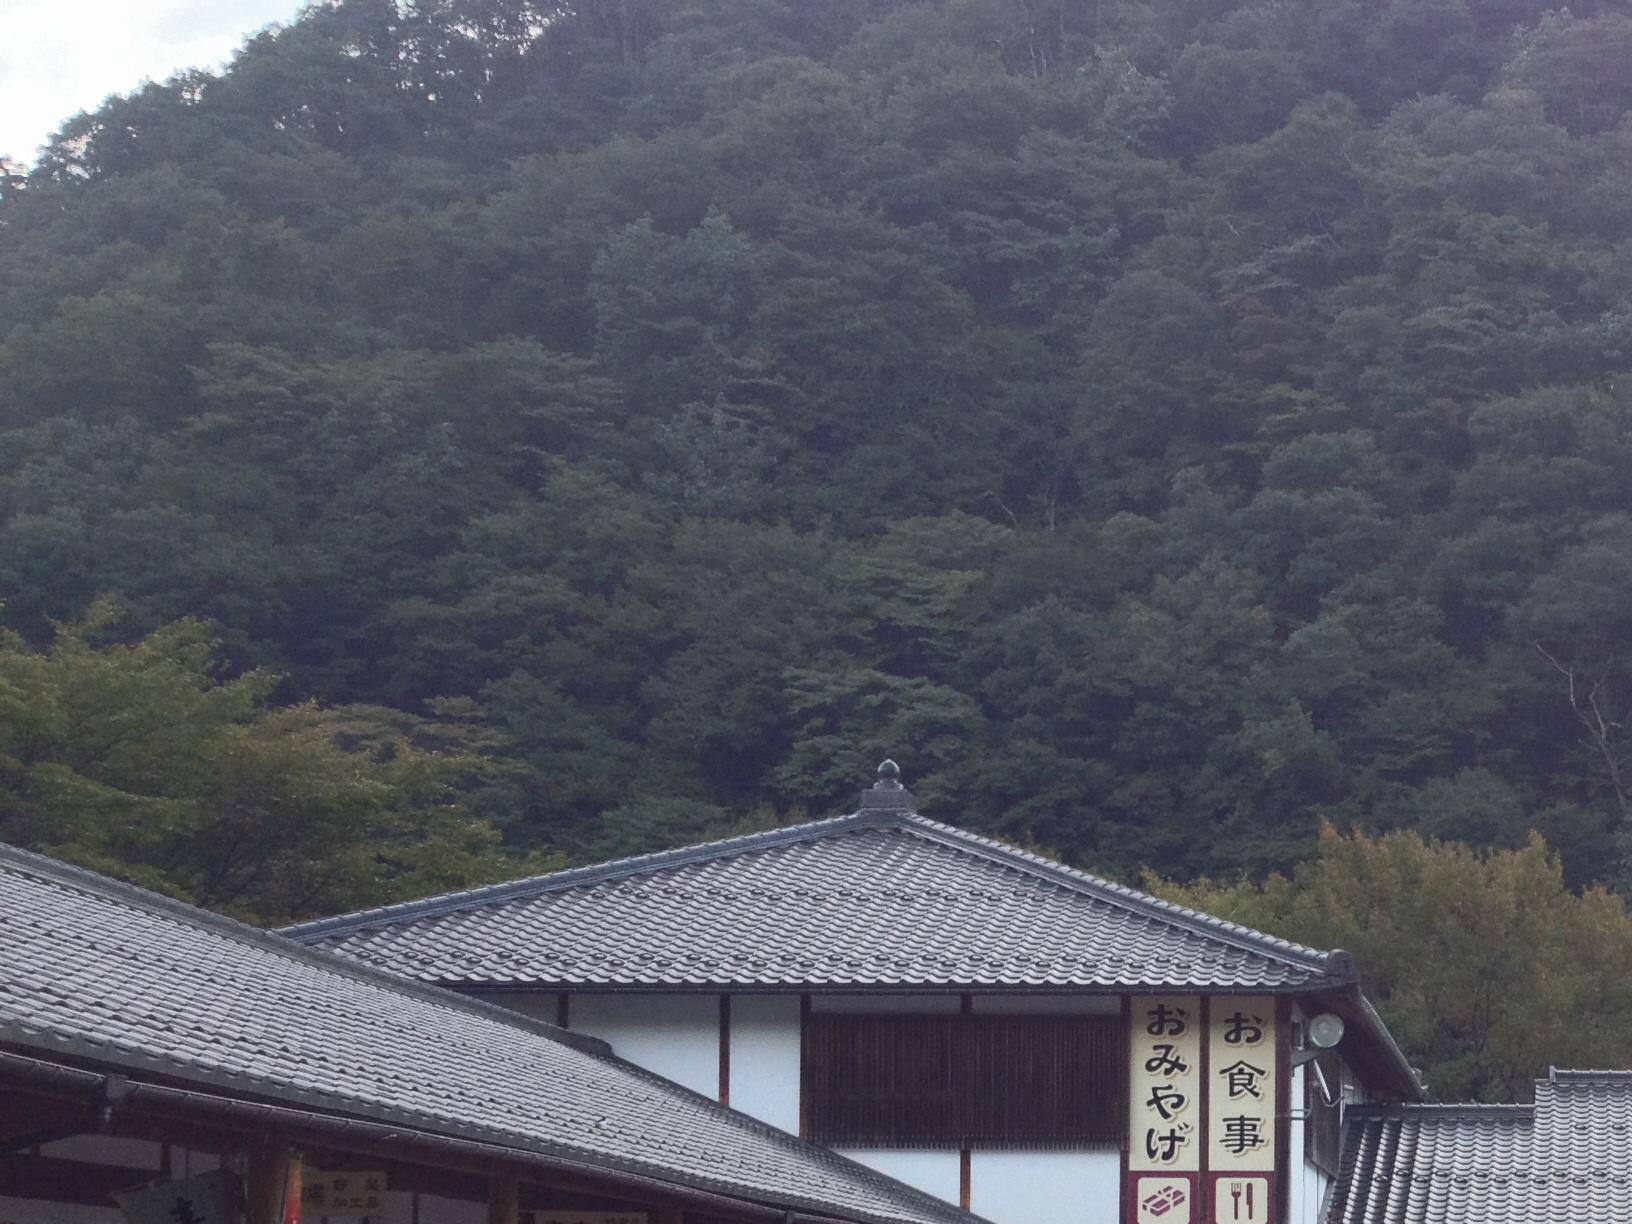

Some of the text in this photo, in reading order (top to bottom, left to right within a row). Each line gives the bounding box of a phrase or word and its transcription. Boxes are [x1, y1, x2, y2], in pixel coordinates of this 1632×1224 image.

[1144, 1003, 1190, 1162] おみやげ
[1218, 1011, 1267, 1156] お食事
